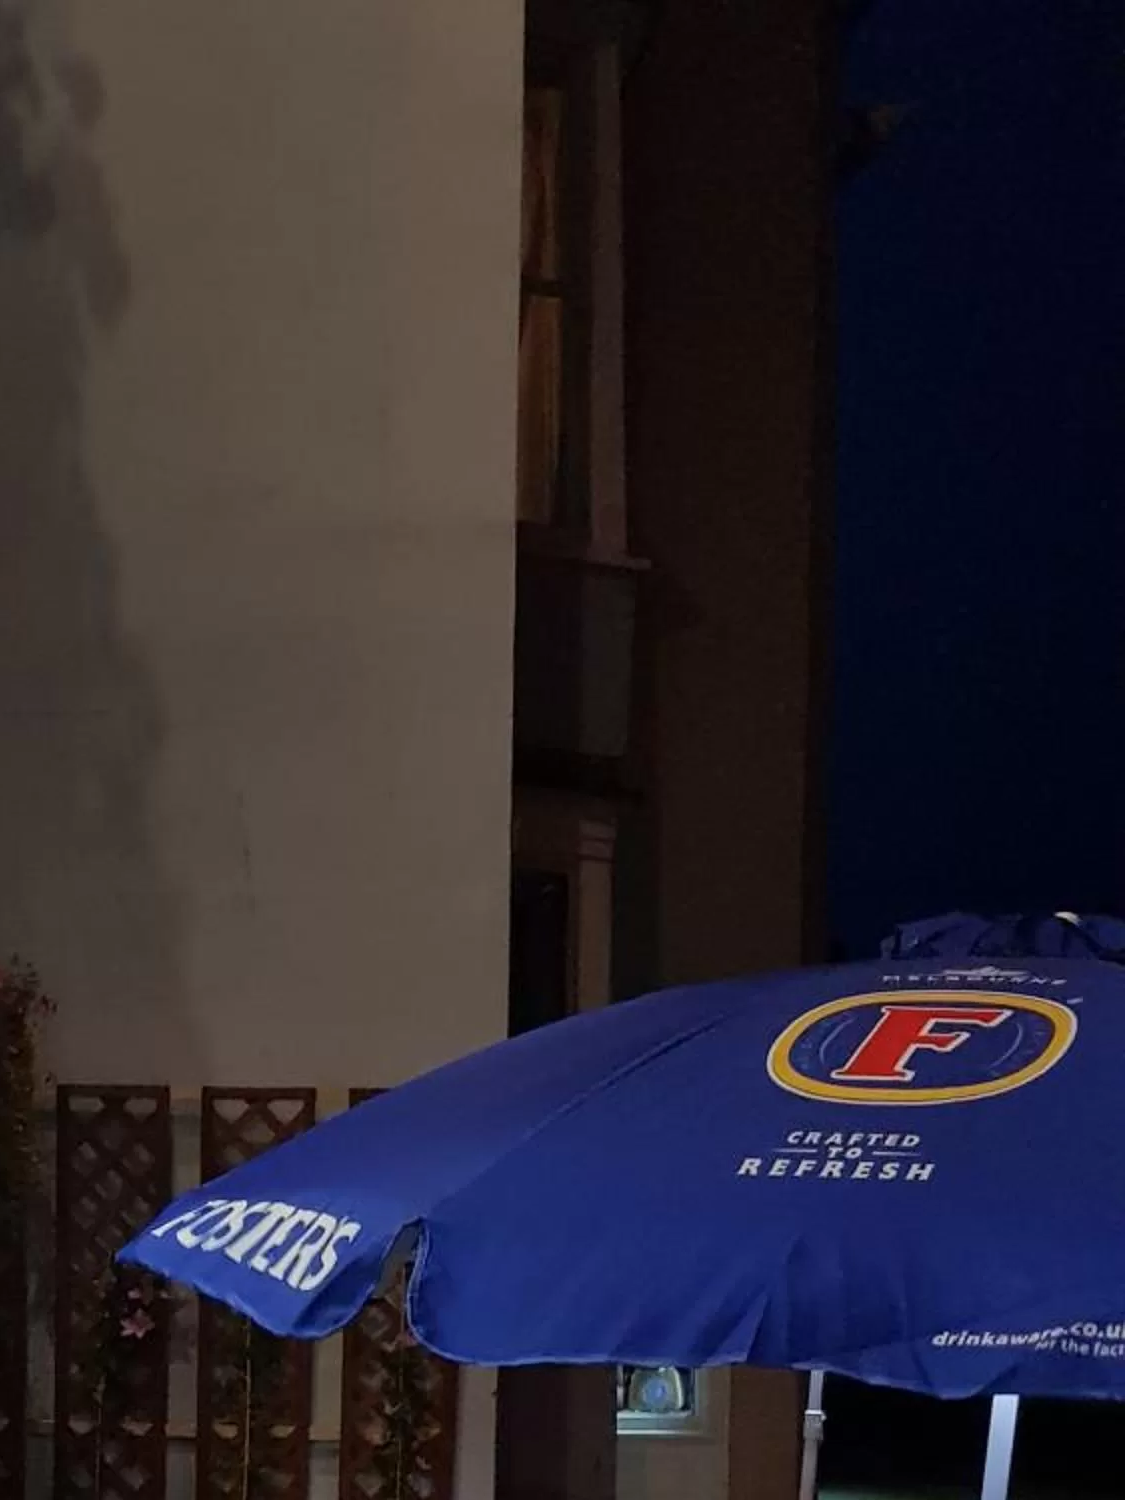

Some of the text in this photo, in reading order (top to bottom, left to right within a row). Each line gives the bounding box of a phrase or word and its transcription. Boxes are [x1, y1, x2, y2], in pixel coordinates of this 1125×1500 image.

[831, 1005, 1016, 1081] F
[786, 1130, 921, 1148] CRAFTED
[827, 1147, 863, 1159] TO
[736, 1157, 936, 1181] REFRESH
[931, 1321, 1125, 1347] drinkaware.co.u
[1093, 1341, 1125, 1357] fact
